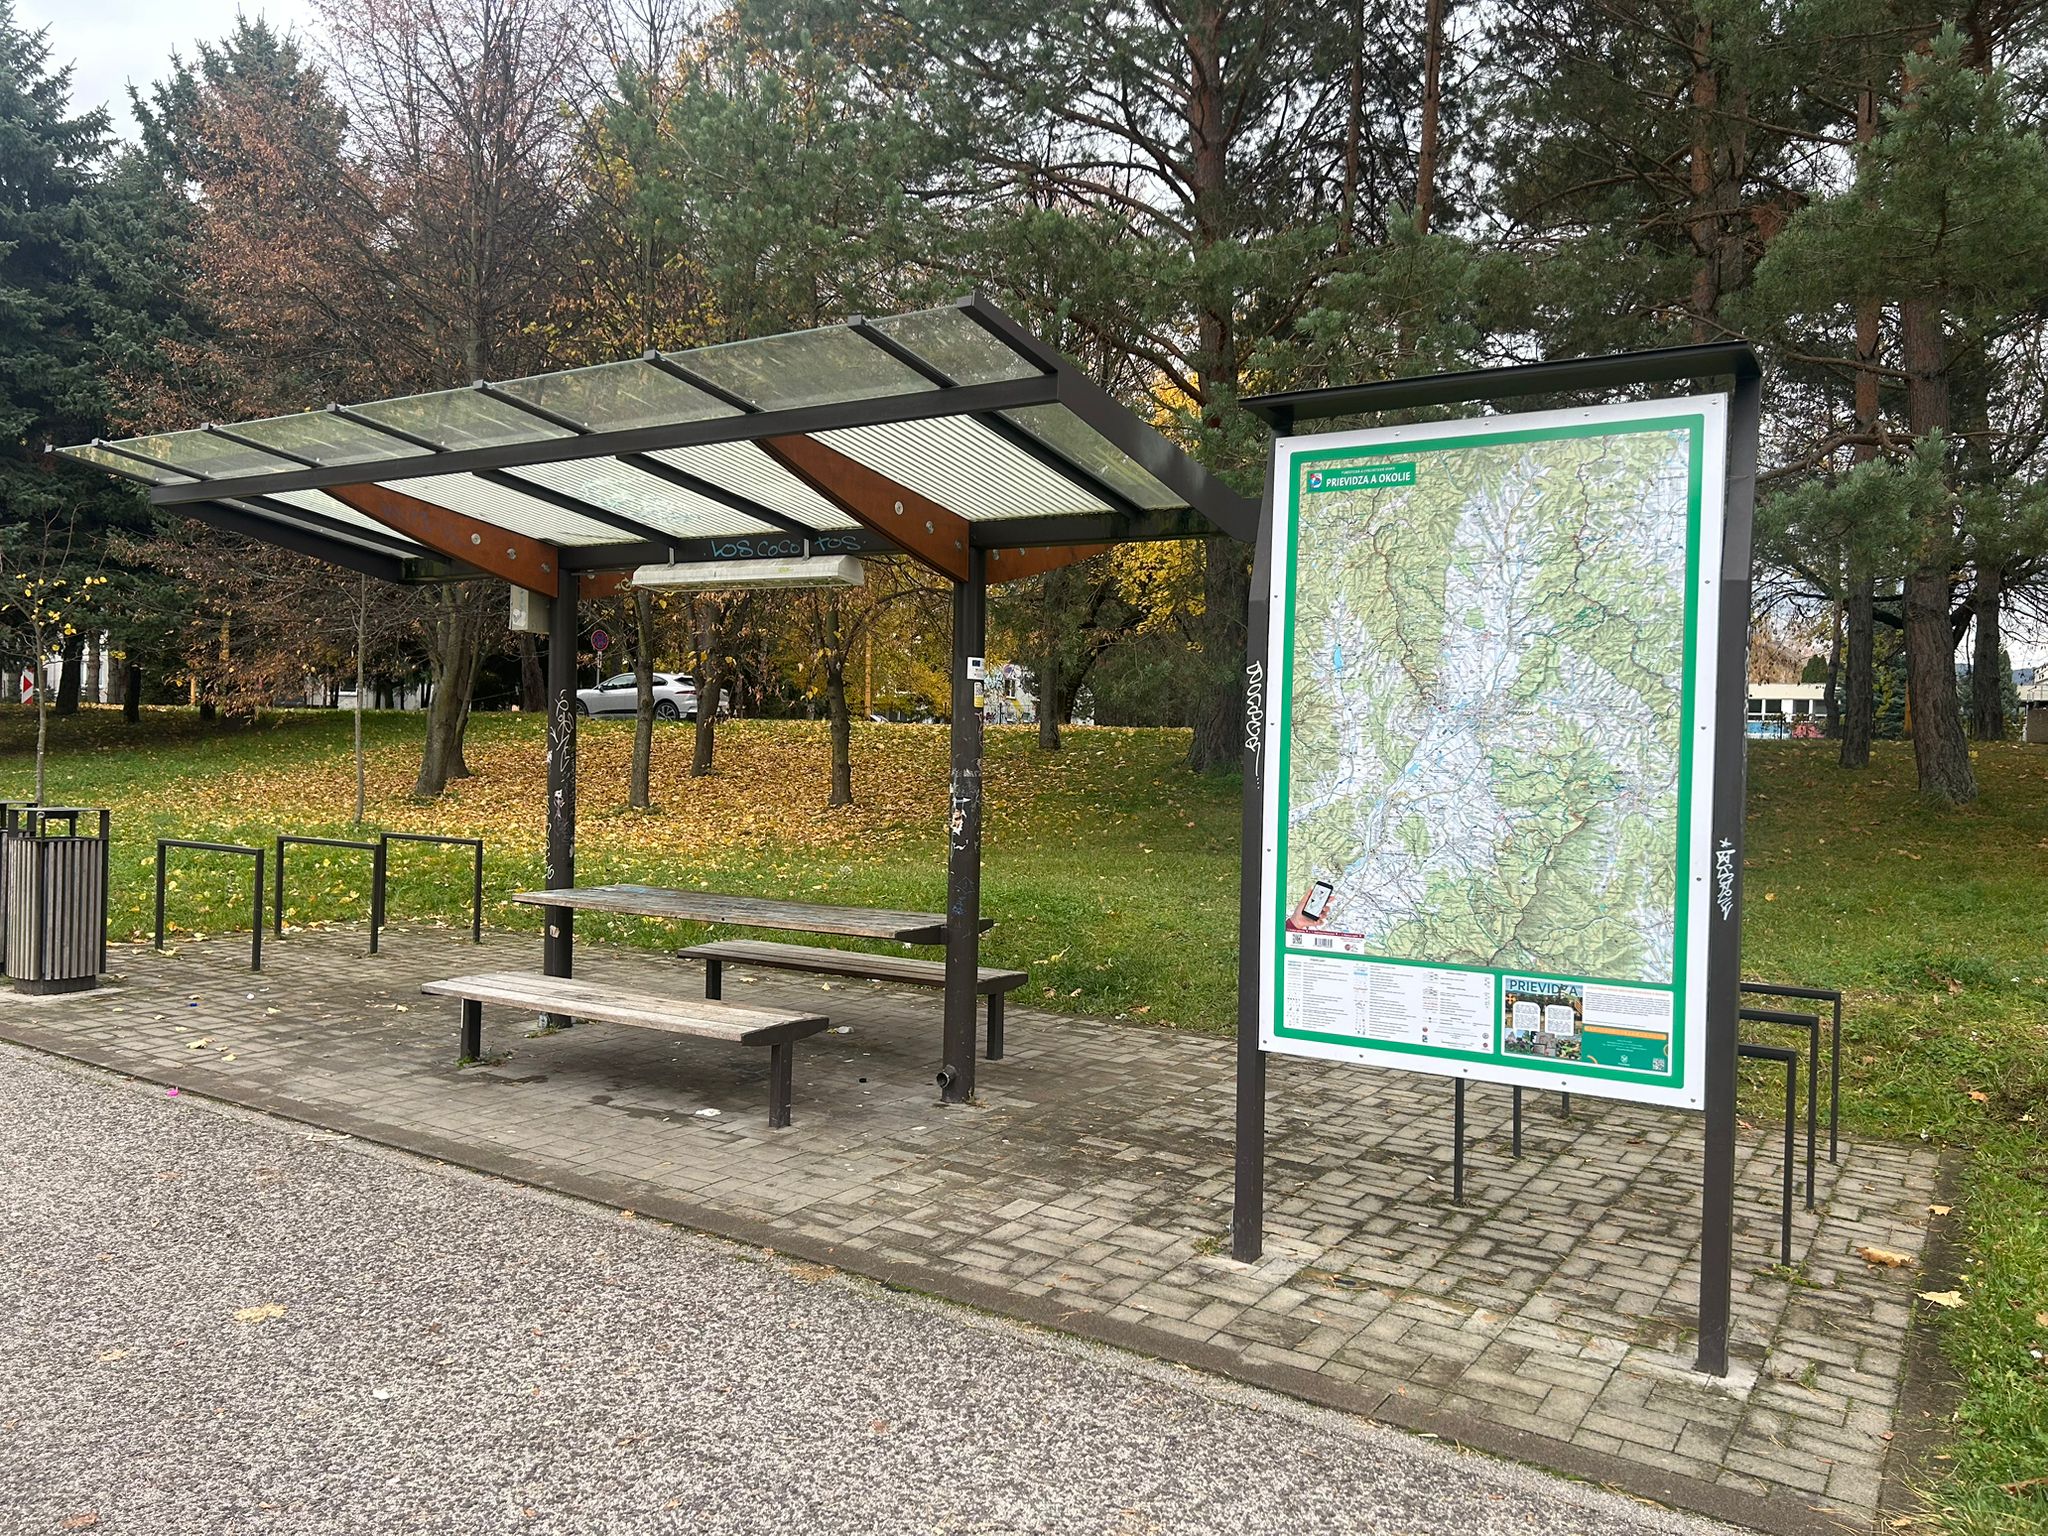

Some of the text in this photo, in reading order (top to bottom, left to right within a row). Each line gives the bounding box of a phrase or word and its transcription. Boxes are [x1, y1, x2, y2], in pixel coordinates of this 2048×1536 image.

[1326, 471, 1411, 488] PRIEVIDZA A OKOLIE
